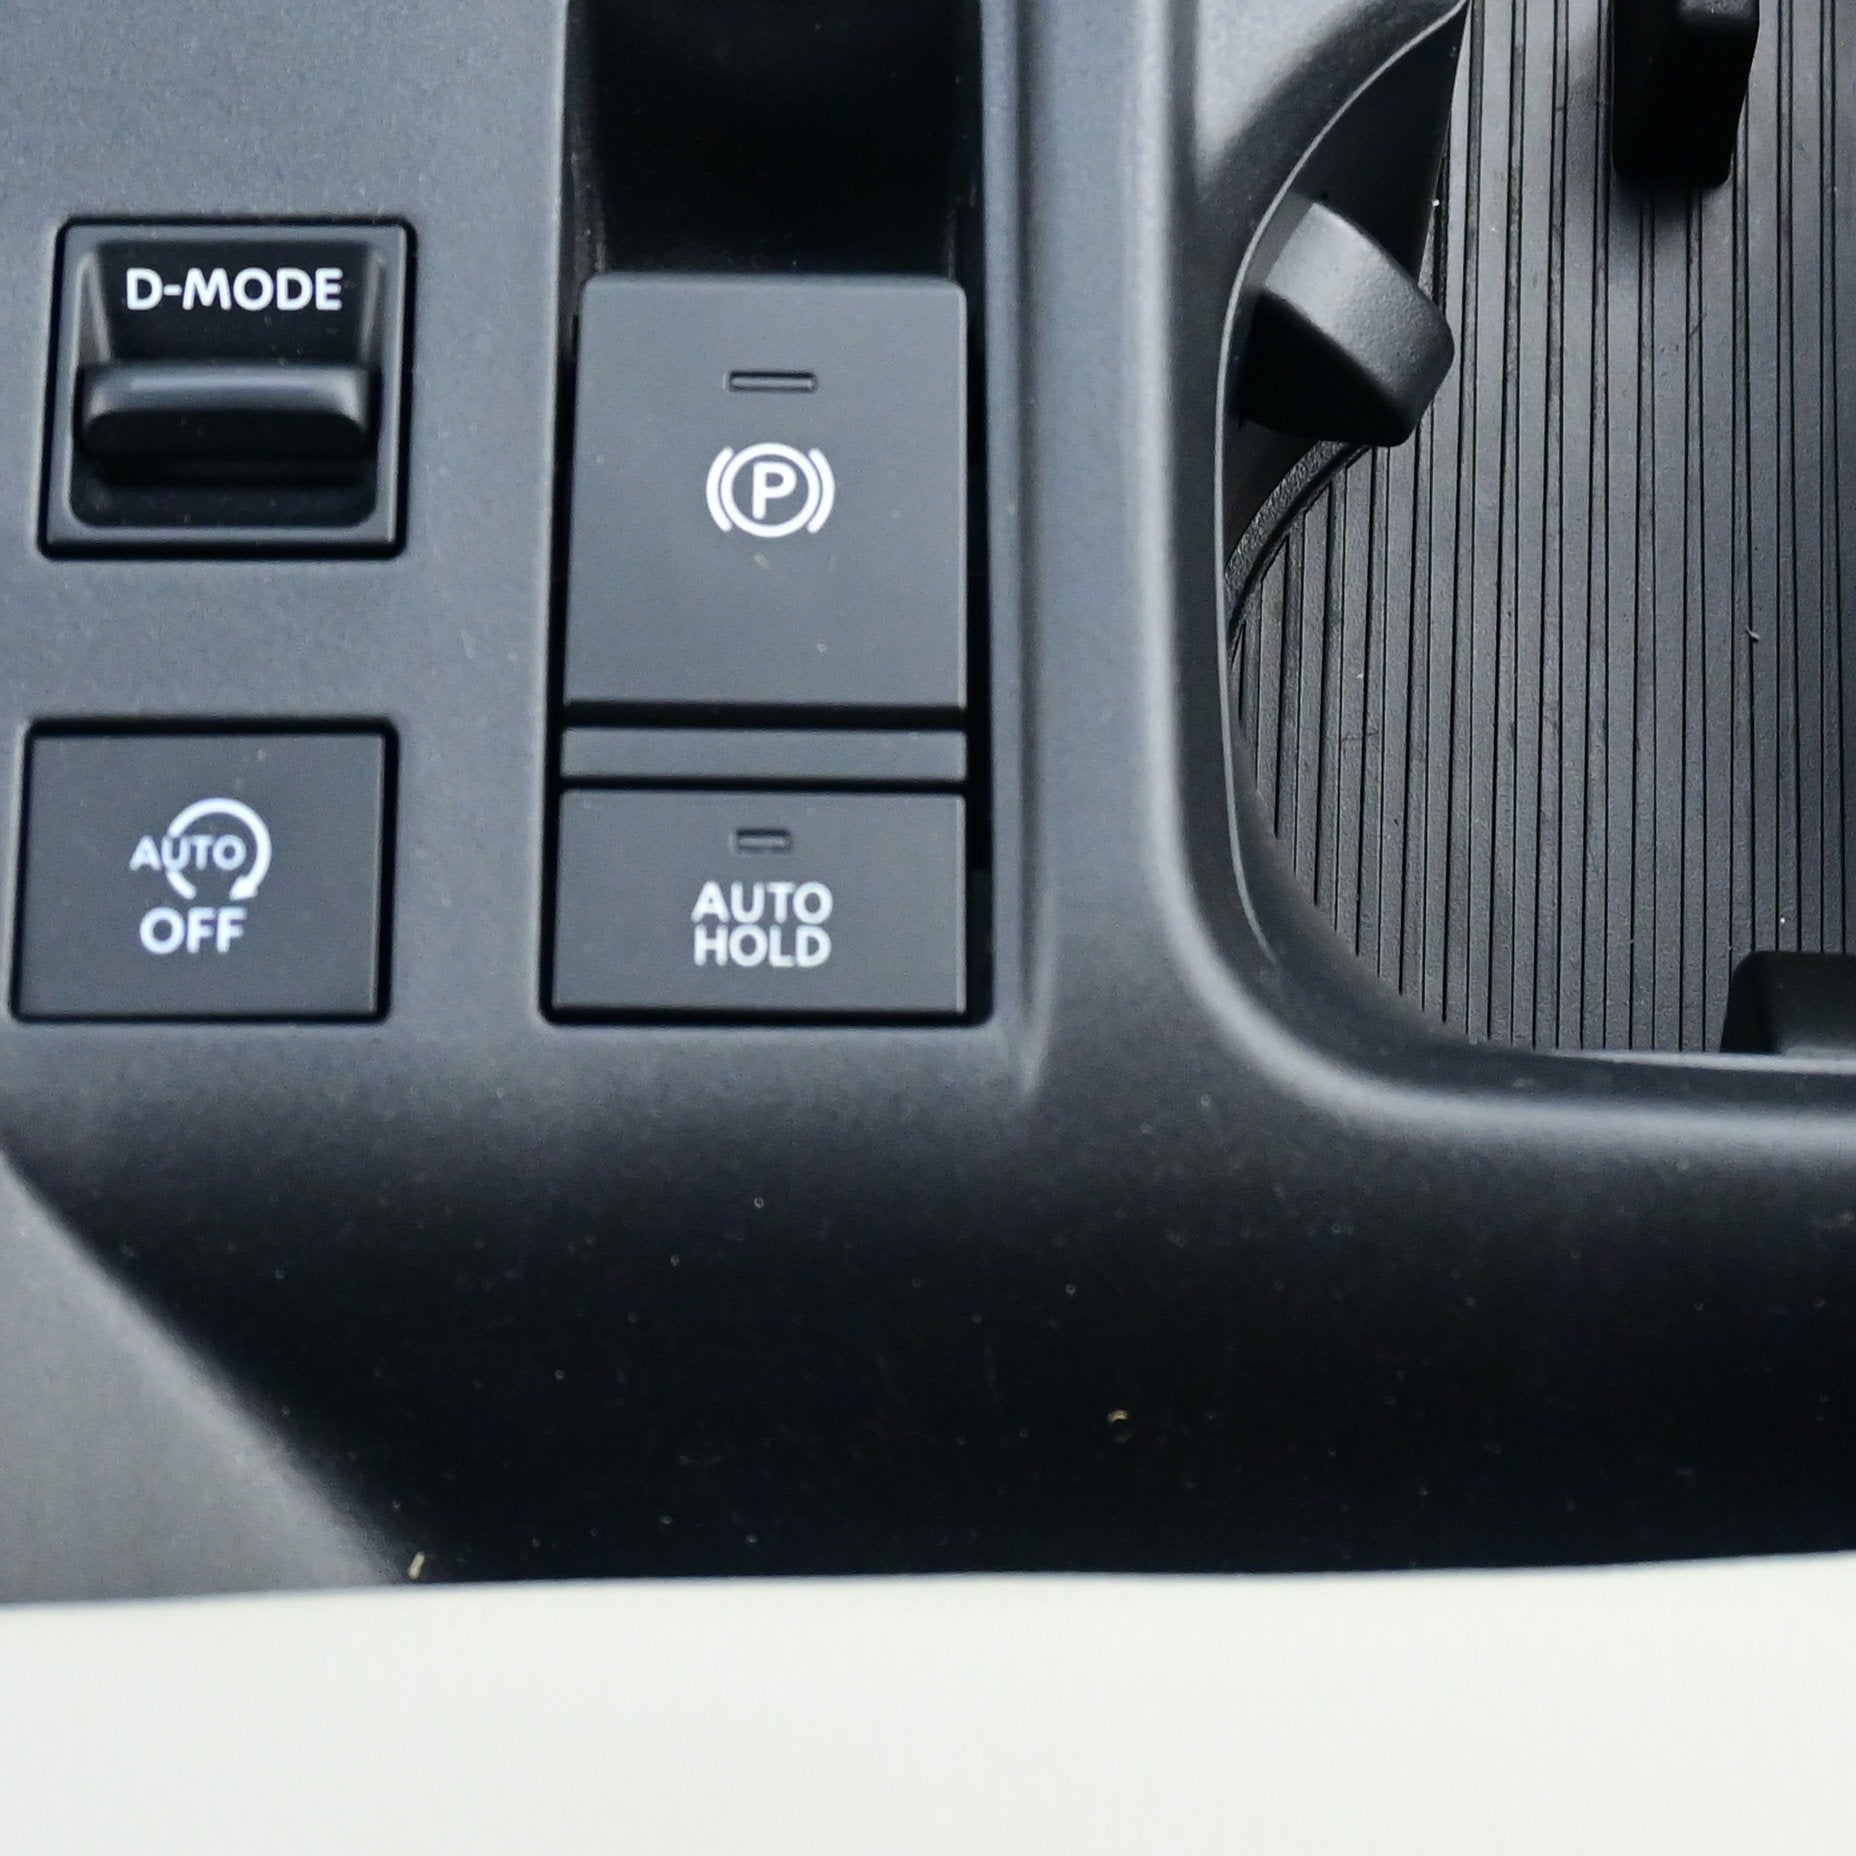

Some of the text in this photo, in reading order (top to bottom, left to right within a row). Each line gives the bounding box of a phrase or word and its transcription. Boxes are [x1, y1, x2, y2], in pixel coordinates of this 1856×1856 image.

[125, 266, 343, 312] D-MODE
[752, 461, 798, 520] P
[129, 834, 246, 871] AUTO
[690, 880, 834, 925] AUTO
[139, 906, 247, 955] OFF
[693, 925, 832, 969] HOLD
